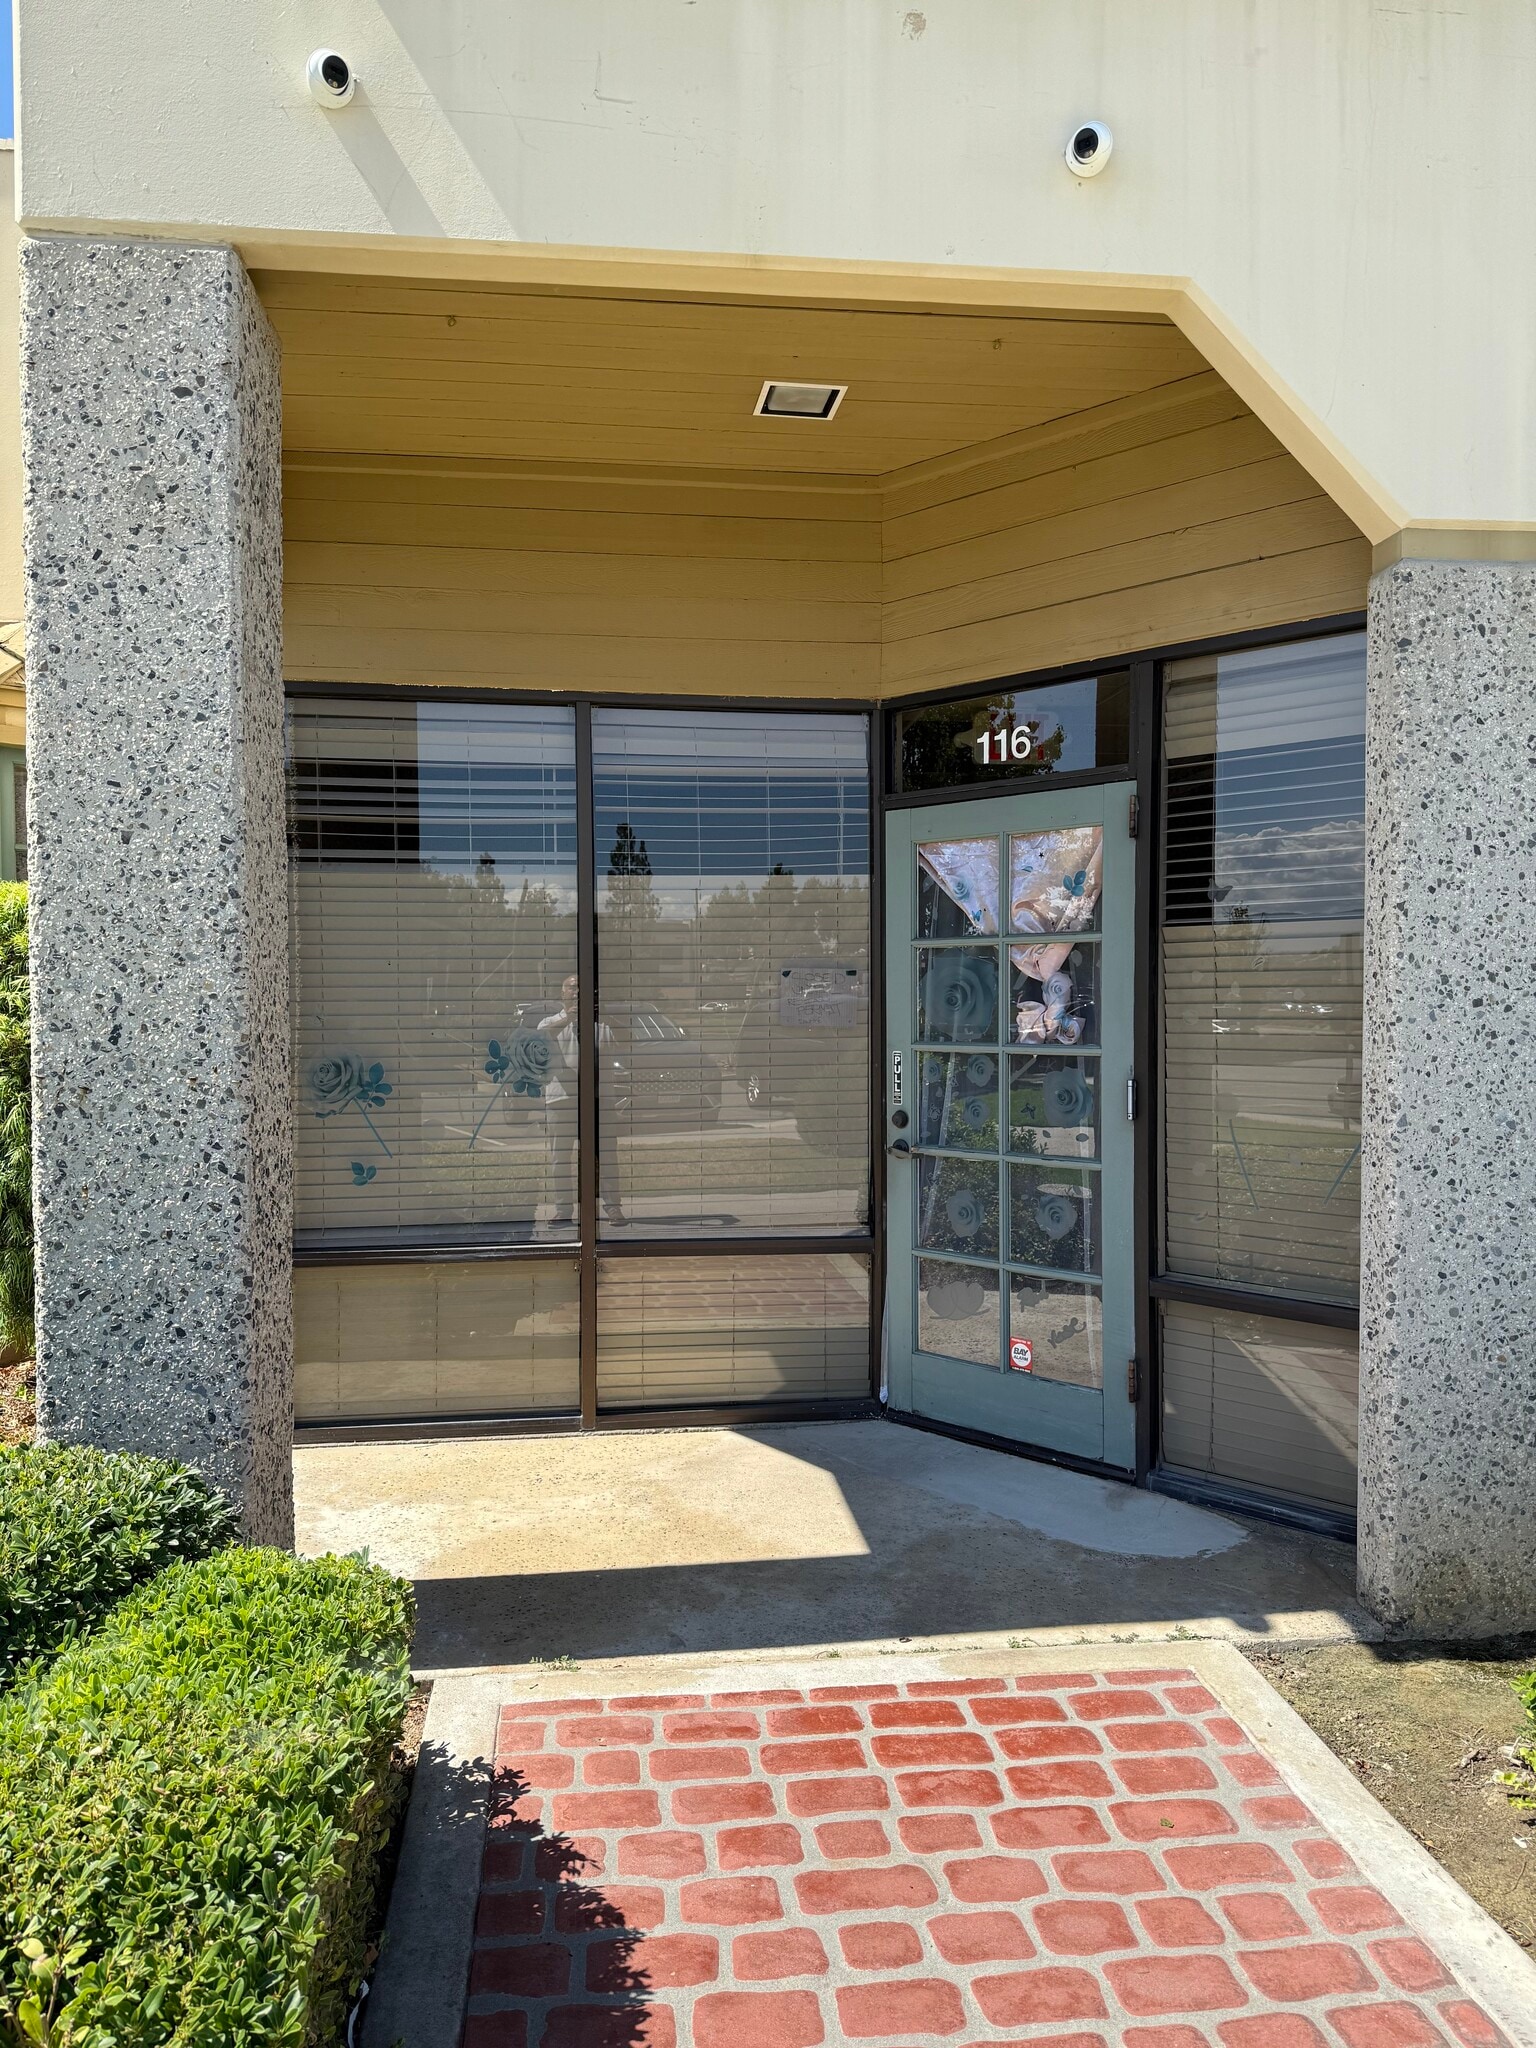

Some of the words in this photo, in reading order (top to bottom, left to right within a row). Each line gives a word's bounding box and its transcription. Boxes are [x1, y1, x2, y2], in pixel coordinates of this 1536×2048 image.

[976, 725, 1031, 764] 116
[1013, 1347, 1029, 1357] BAY
[1013, 1354, 1029, 1362] ALARM
